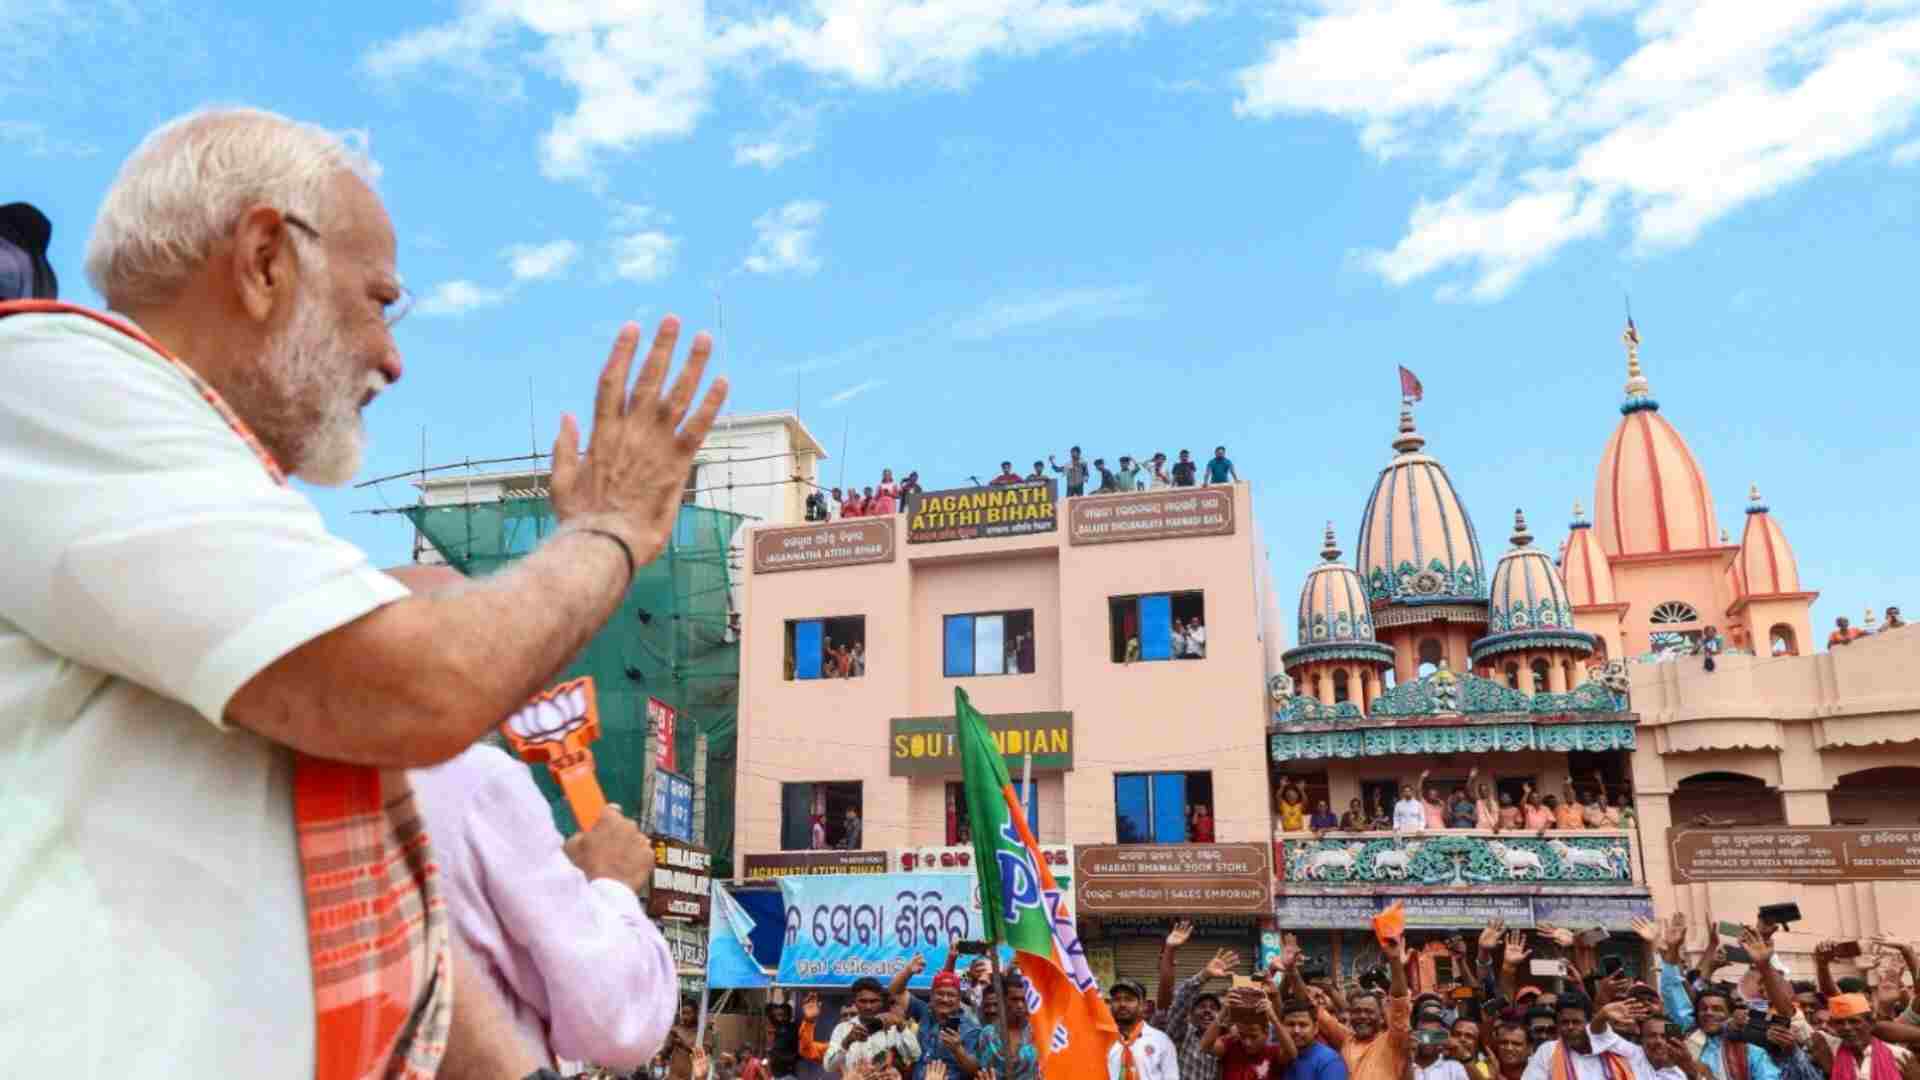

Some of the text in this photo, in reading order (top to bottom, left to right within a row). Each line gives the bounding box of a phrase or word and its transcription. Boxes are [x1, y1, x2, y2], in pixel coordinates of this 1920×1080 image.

[920, 487, 1048, 513] JAGANNATH
[912, 502, 1054, 529] ATITHI BIHAR
[825, 545, 851, 559] ATITHI
[855, 542, 882, 556] BIHAR
[895, 728, 1068, 758] SOUT NDIAN
[1093, 863, 1136, 873] BHARATI
[1216, 863, 1249, 873] STORE
[1171, 888, 1201, 899] SALES
[1204, 888, 1262, 899] EMPORIUM
[812, 904, 883, 946] ସେବା
[895, 890, 969, 947] ଶିବିର
